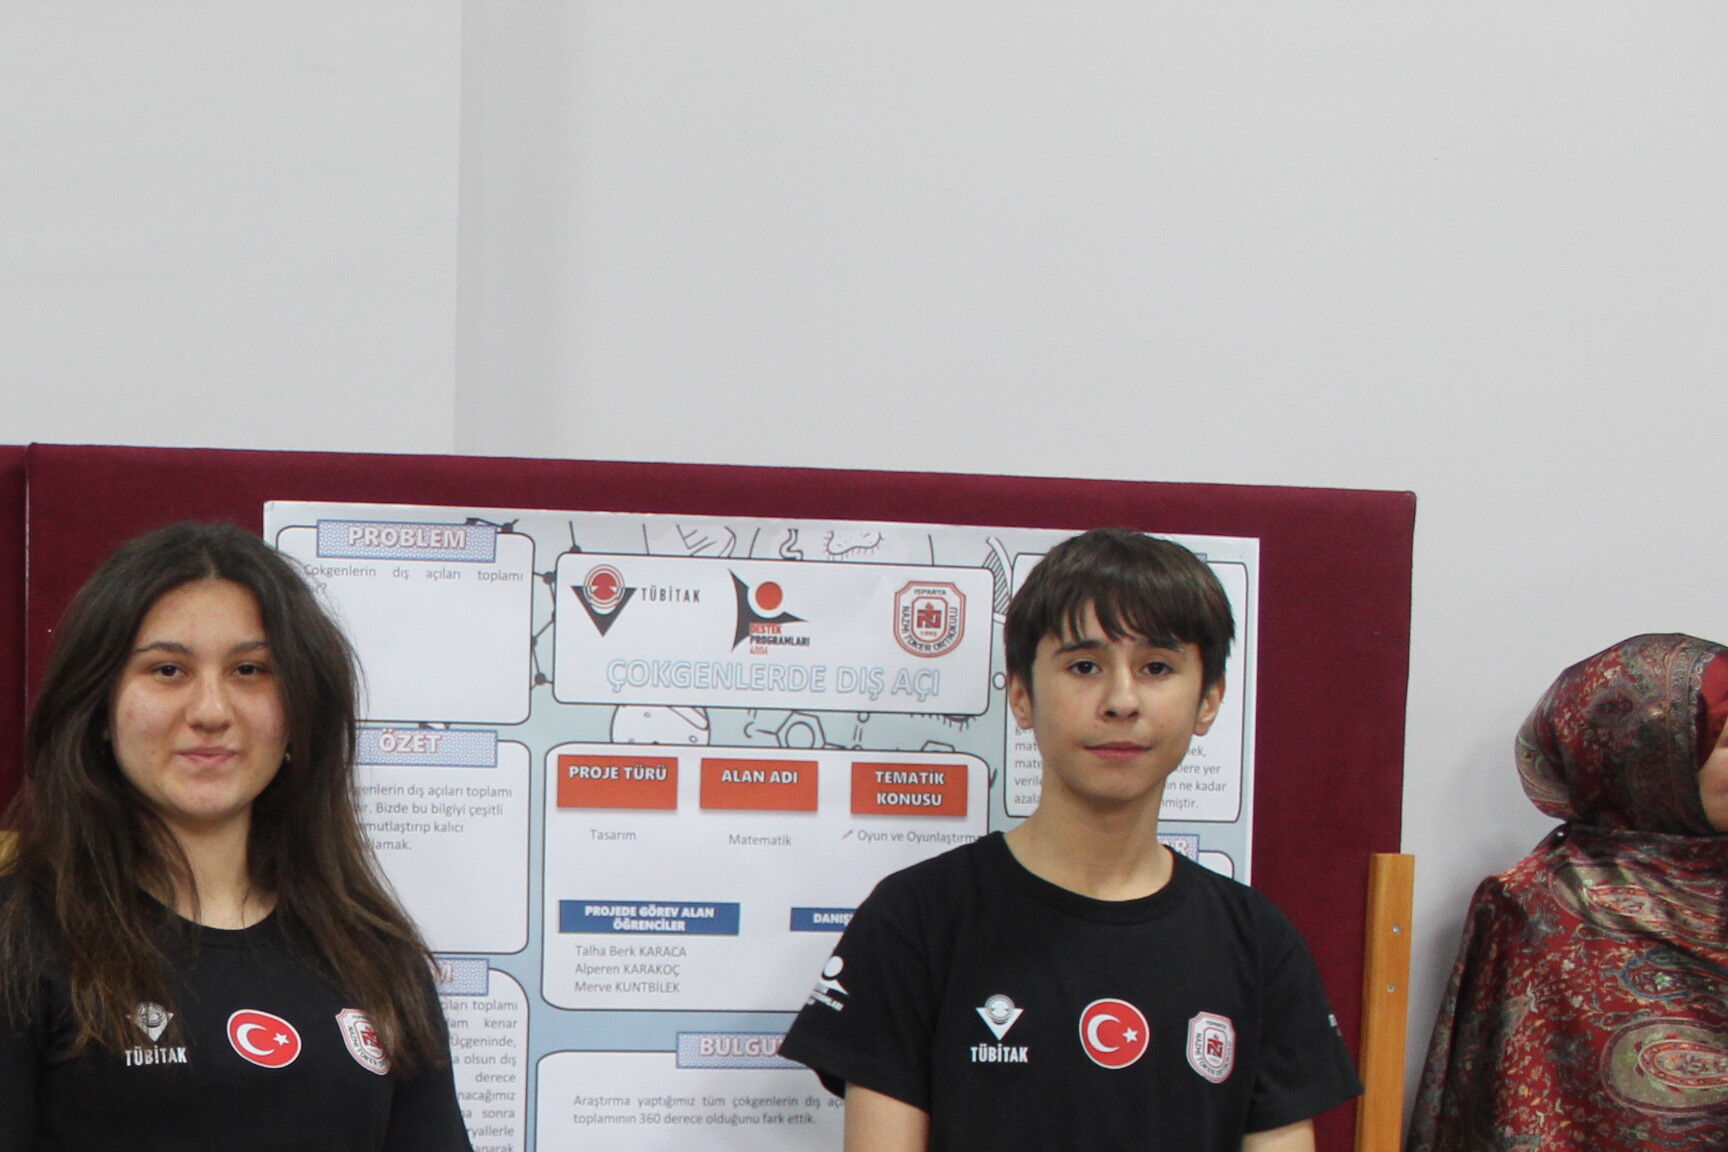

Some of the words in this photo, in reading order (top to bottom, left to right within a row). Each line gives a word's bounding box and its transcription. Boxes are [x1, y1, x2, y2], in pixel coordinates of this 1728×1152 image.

[348, 526, 468, 550] PROBLEM
[392, 567, 410, 581] dış
[425, 568, 461, 582] açıları
[477, 569, 524, 584] toplamı
[640, 586, 700, 603] TÜBİTAK
[607, 658, 827, 694] ÇOKGENLERDE
[835, 664, 885, 701] DIŞ
[890, 667, 941, 698] AÇI
[378, 728, 443, 754] ÖZET
[569, 766, 621, 781] PROJE
[624, 764, 668, 781] TÜRÜ
[721, 770, 766, 784] ALAN
[769, 770, 799, 784] ADI
[875, 768, 946, 786] TEMATİK
[1203, 765, 1221, 776] yer
[408, 784, 425, 798] dış
[428, 785, 463, 798] açıları
[466, 786, 512, 800] toplamı
[1179, 782, 1192, 792] ne
[1196, 782, 1227, 793] kadar
[876, 792, 943, 807] KONUSU
[375, 804, 409, 815] Bizde
[412, 804, 428, 815] bu
[431, 804, 466, 818] bilgiyi
[468, 805, 504, 819] çeşitli
[433, 822, 464, 834] kalıcı
[590, 829, 637, 842] Tasarım
[728, 833, 792, 848] Matematik
[857, 830, 889, 844] Oyun
[892, 832, 905, 843] ve
[585, 906, 637, 918] PROJEDE
[639, 904, 678, 919] GÖREV
[680, 907, 715, 919] ALAN
[613, 917, 686, 932] ÖĞRENCİLER
[575, 945, 607, 958] Talha
[609, 945, 636, 958] Berk
[639, 946, 687, 958] KARACA
[575, 963, 621, 978] Alperen
[623, 964, 681, 978] KARAKOÇ
[575, 982, 613, 993] Merve
[615, 979, 681, 993] KUNTBİLEK
[472, 999, 518, 1012] toplamı
[484, 1018, 518, 1029] kenar
[124, 1045, 188, 1068] TÜBİTAK
[464, 1053, 496, 1065] olsun
[500, 1053, 517, 1067] dış
[970, 1042, 1029, 1064] TÜBİTAK
[475, 1071, 516, 1083] derece
[573, 1094, 632, 1108] Araştırma
[637, 1094, 696, 1109] yaptığımız
[702, 1094, 727, 1107] tüm
[731, 1094, 800, 1110] çokgenlerin
[804, 1094, 822, 1109] dış
[481, 1109, 515, 1119] sonra
[573, 1112, 636, 1127] toplamının
[639, 1112, 661, 1125] 360
[663, 1112, 703, 1125] derece
[705, 1112, 761, 1127] olduğunu
[762, 1111, 785, 1125] fark
[787, 1112, 817, 1125] ettik.
